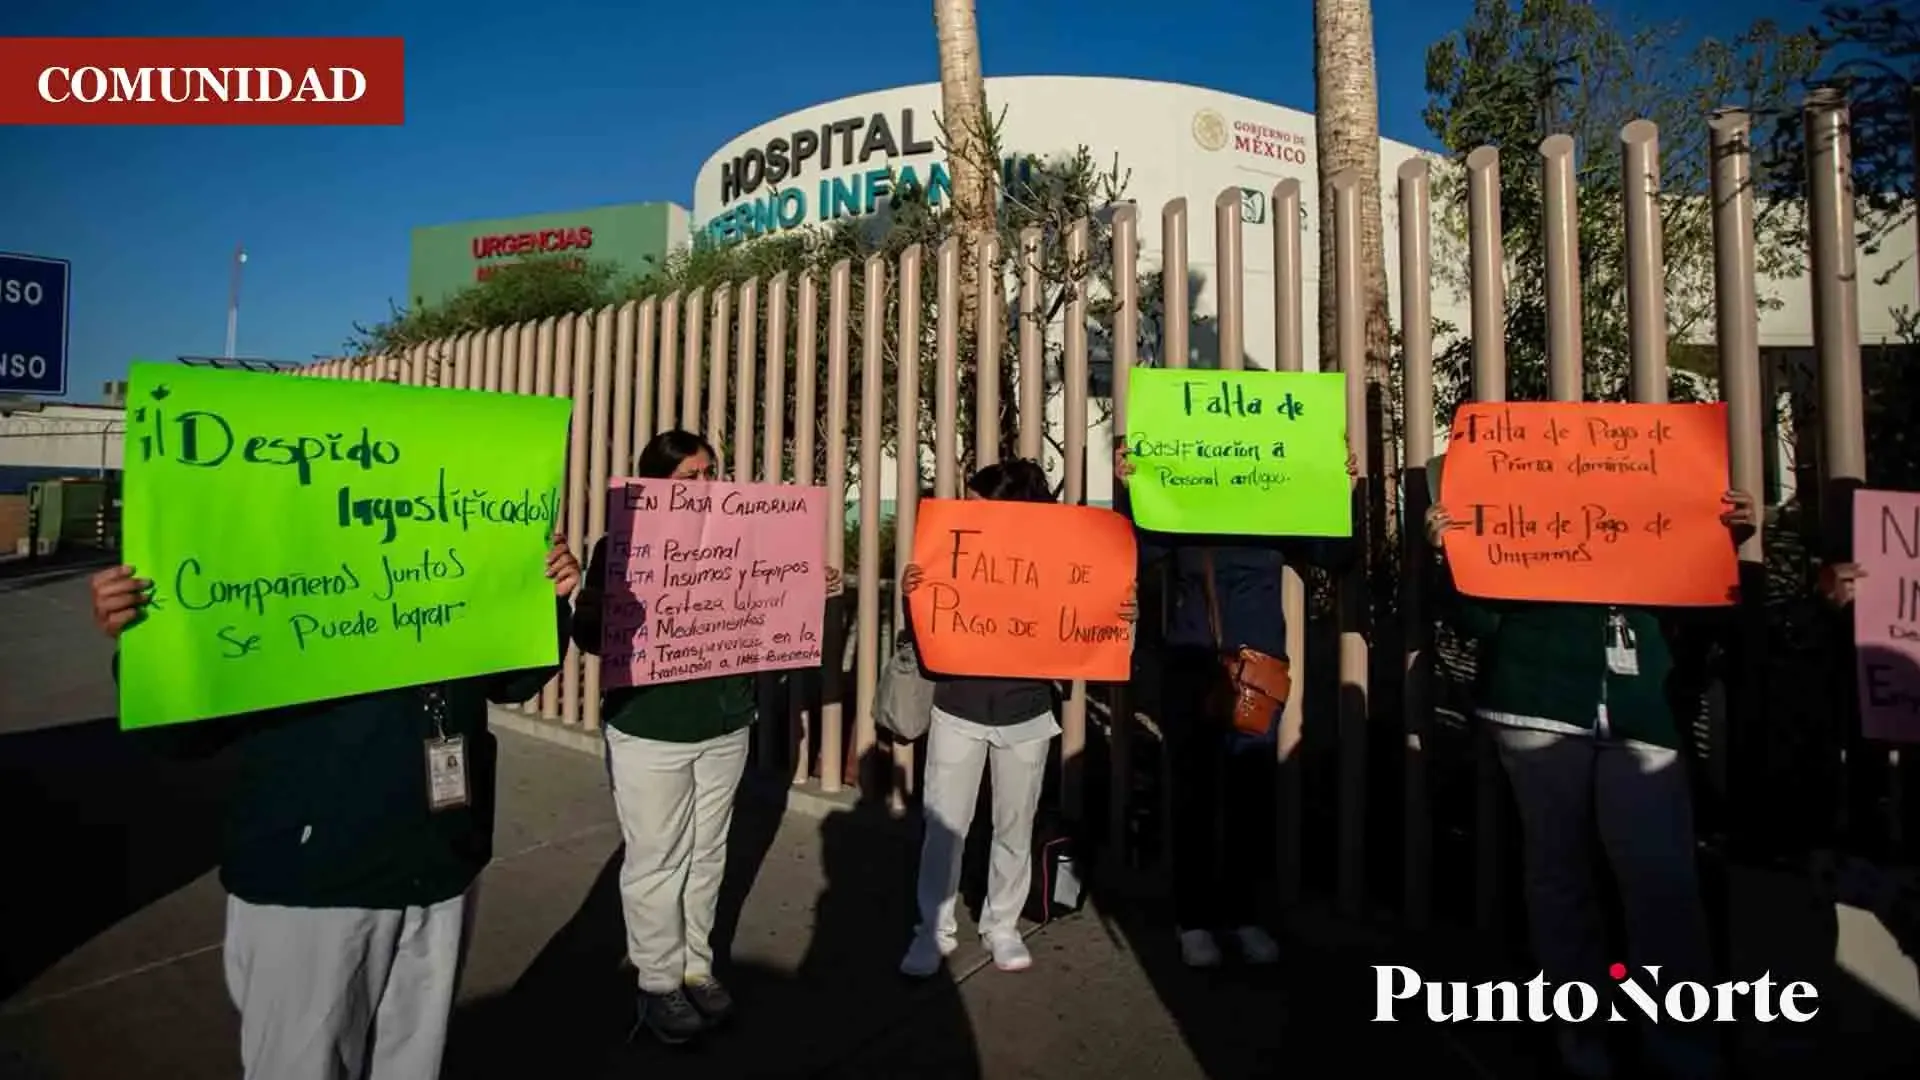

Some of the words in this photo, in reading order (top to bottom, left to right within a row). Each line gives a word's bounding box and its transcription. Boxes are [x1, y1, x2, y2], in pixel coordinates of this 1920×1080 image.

[1234, 120, 1291, 142] GOBIERNO
[1293, 133, 1306, 145] DE
[721, 108, 933, 206] HOSPITAL
[696, 187, 807, 245] TERNO
[473, 225, 593, 258] URGENCIAS
[0, 279, 43, 306] SO
[1173, 380, 1262, 418] Falta
[1276, 392, 1304, 421] de
[1543, 418, 1570, 446] de
[1585, 416, 1639, 450] Pago
[1648, 419, 1674, 445] de
[624, 482, 658, 512] EN
[670, 483, 712, 514] BAJA
[721, 490, 809, 516] CALIFORNIA
[1546, 511, 1571, 539] de
[1581, 503, 1629, 543] Pago
[1644, 511, 1673, 540] de
[663, 537, 741, 564] Personal
[949, 529, 1040, 589] FALTA
[1068, 562, 1092, 584] DE
[175, 558, 359, 615] Compañeros
[663, 560, 732, 589] Insumos
[738, 567, 748, 590] y
[751, 559, 809, 586] Equipos
[655, 593, 724, 616] Certeza
[927, 582, 998, 636] PAGO
[1008, 617, 1039, 639] DE
[216, 625, 261, 659] Se
[772, 632, 792, 644] en
[799, 622, 817, 642] la
[719, 658, 731, 669] a
